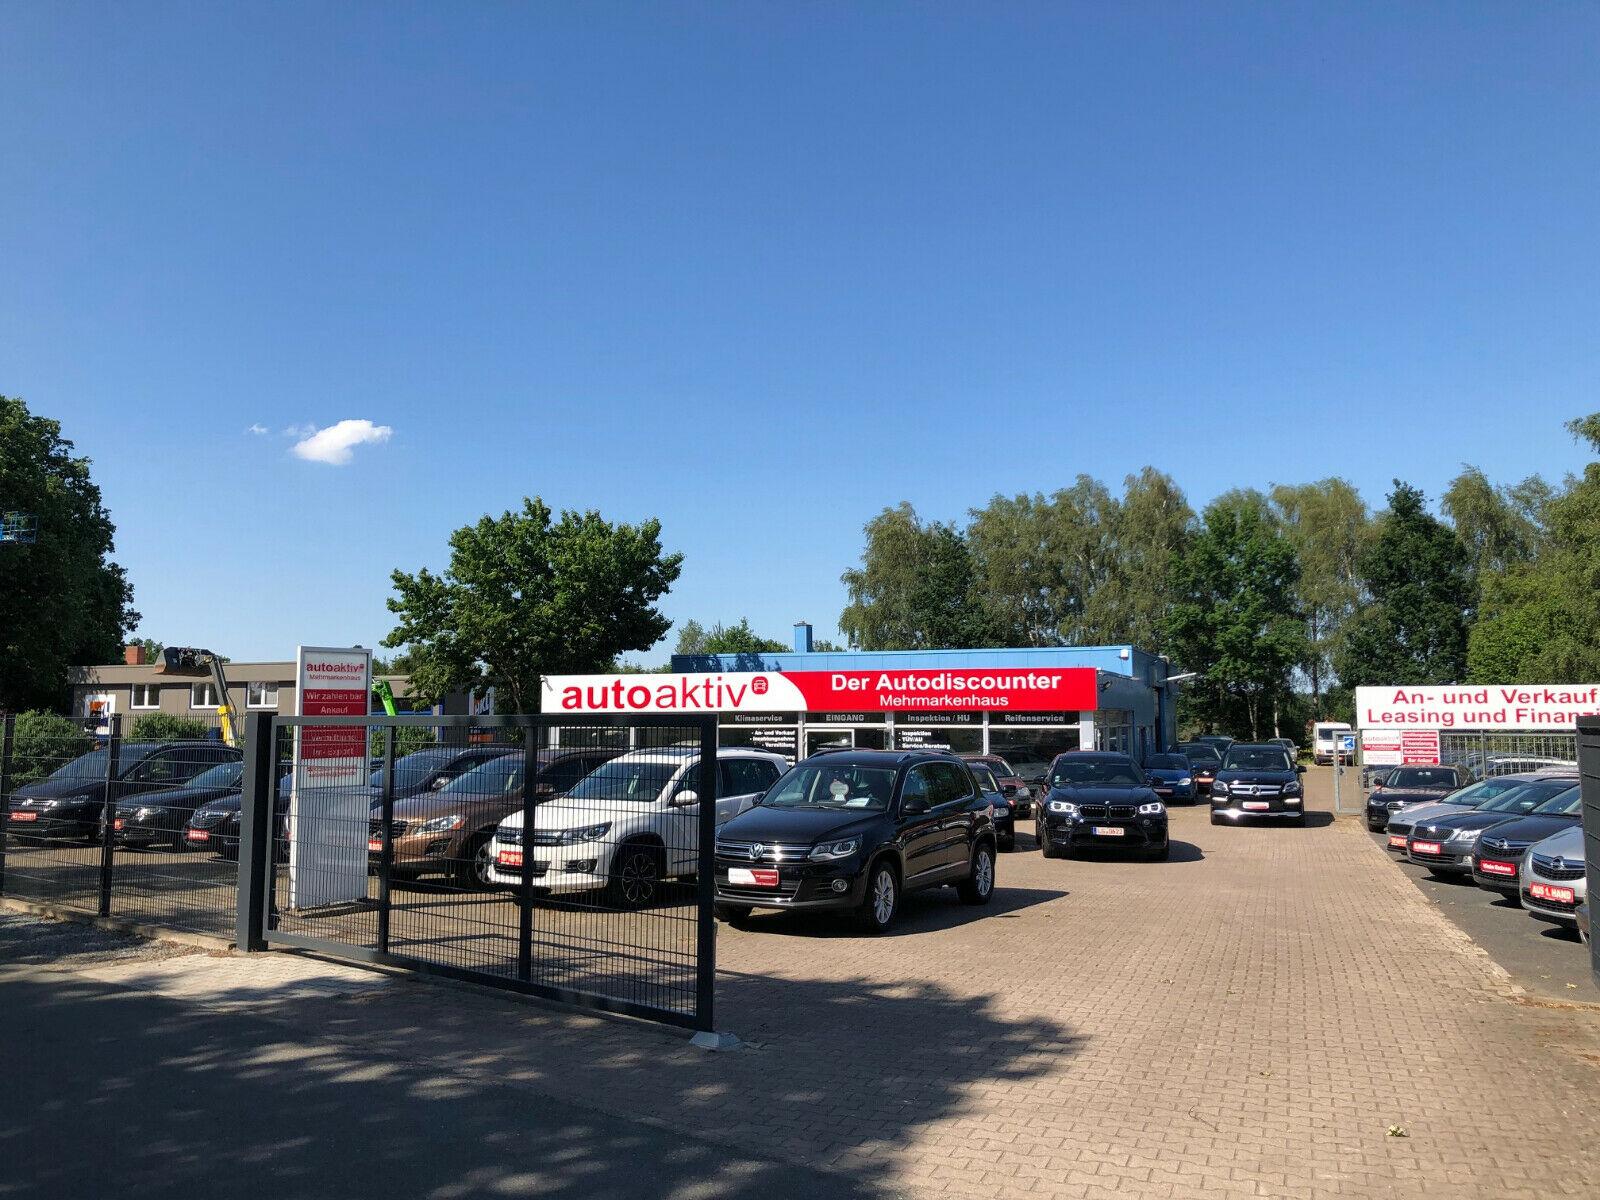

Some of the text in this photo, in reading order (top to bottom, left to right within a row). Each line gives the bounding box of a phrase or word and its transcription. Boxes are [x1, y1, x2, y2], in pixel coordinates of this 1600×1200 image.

[306, 662, 358, 673] autoaktiv
[831, 672, 1062, 691] Der Autodiscounter
[306, 692, 320, 700] Wir
[561, 676, 747, 709] autoaktiv
[1392, 688, 1598, 704] An- und Verkauf
[879, 694, 1009, 707] Mehrmarkenhaus
[320, 706, 349, 714] Ankauf
[734, 714, 783, 722] Klimaservice
[825, 714, 865, 722] EINGANG
[907, 714, 951, 723] Inspektion
[957, 714, 970, 722] HU
[1004, 714, 1064, 722] Reifenservice
[1367, 708, 1455, 727] Leasing
[1463, 708, 1507, 723] und
